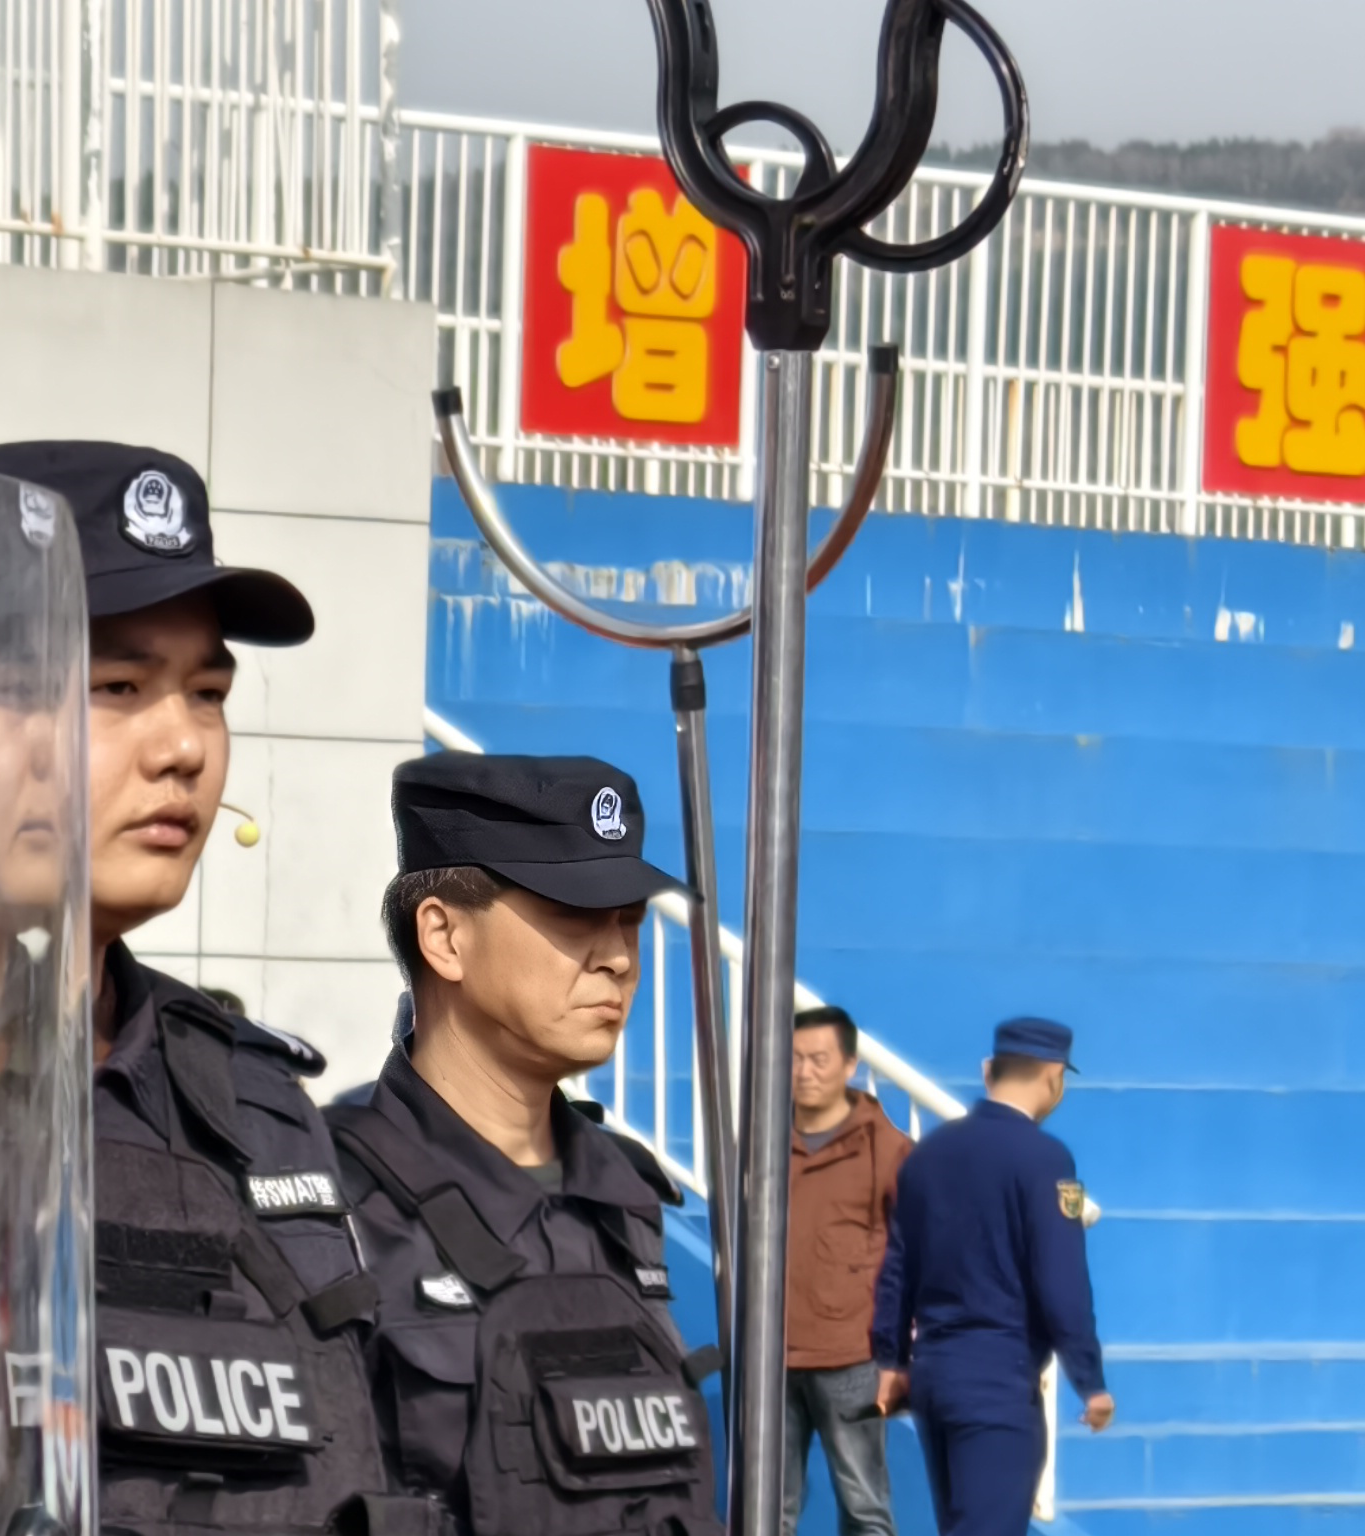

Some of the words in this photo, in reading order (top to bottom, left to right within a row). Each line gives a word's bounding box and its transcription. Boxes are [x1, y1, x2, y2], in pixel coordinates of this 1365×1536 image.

[556, 188, 717, 424] 增
[1235, 254, 1365, 477] 强
[106, 1348, 309, 1441] POLICE
[572, 1396, 697, 1454] POLICE
